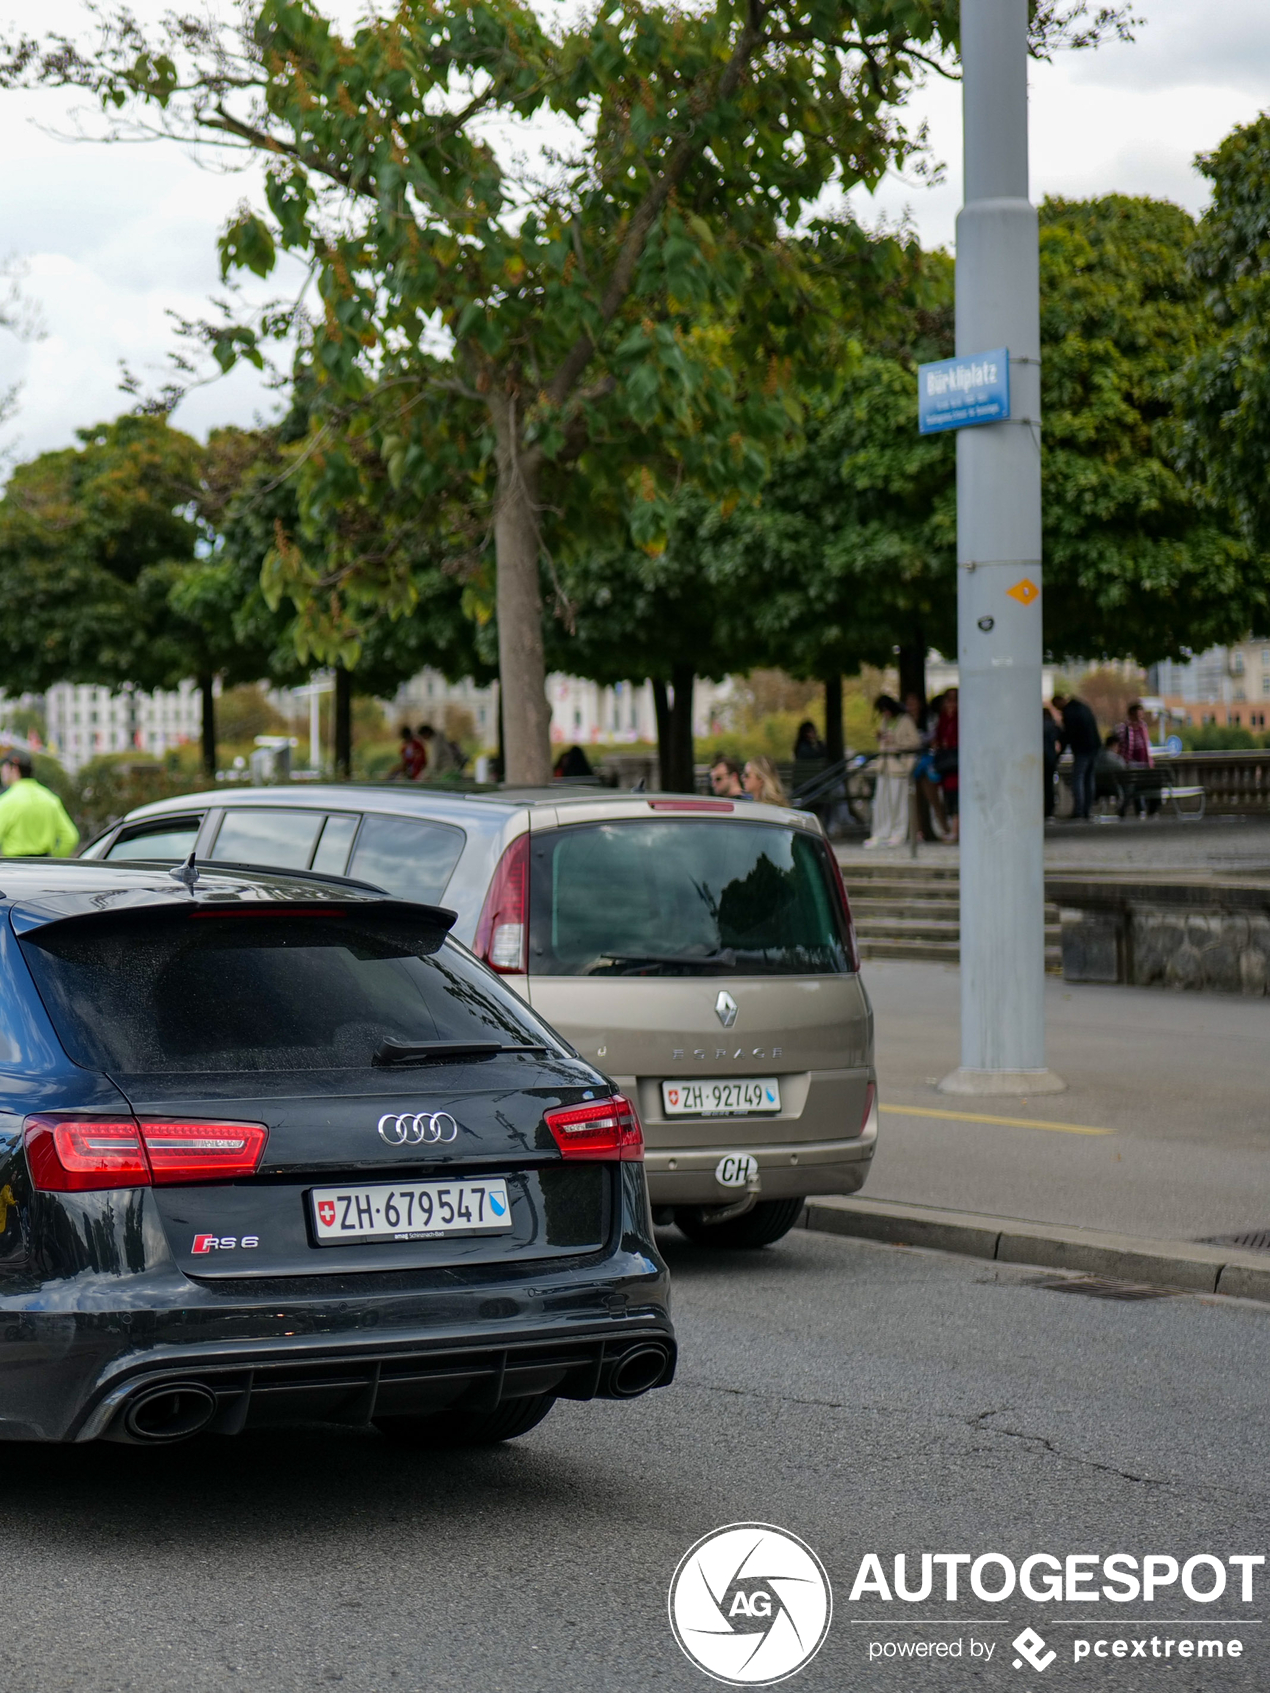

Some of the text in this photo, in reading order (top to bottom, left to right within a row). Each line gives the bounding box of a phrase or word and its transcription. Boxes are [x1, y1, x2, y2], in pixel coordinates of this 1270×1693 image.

[926, 361, 998, 397] Bürkliplatz
[722, 1157, 750, 1182] CH
[336, 1187, 486, 1231] ZH·679547
[394, 1232, 409, 1240] amag
